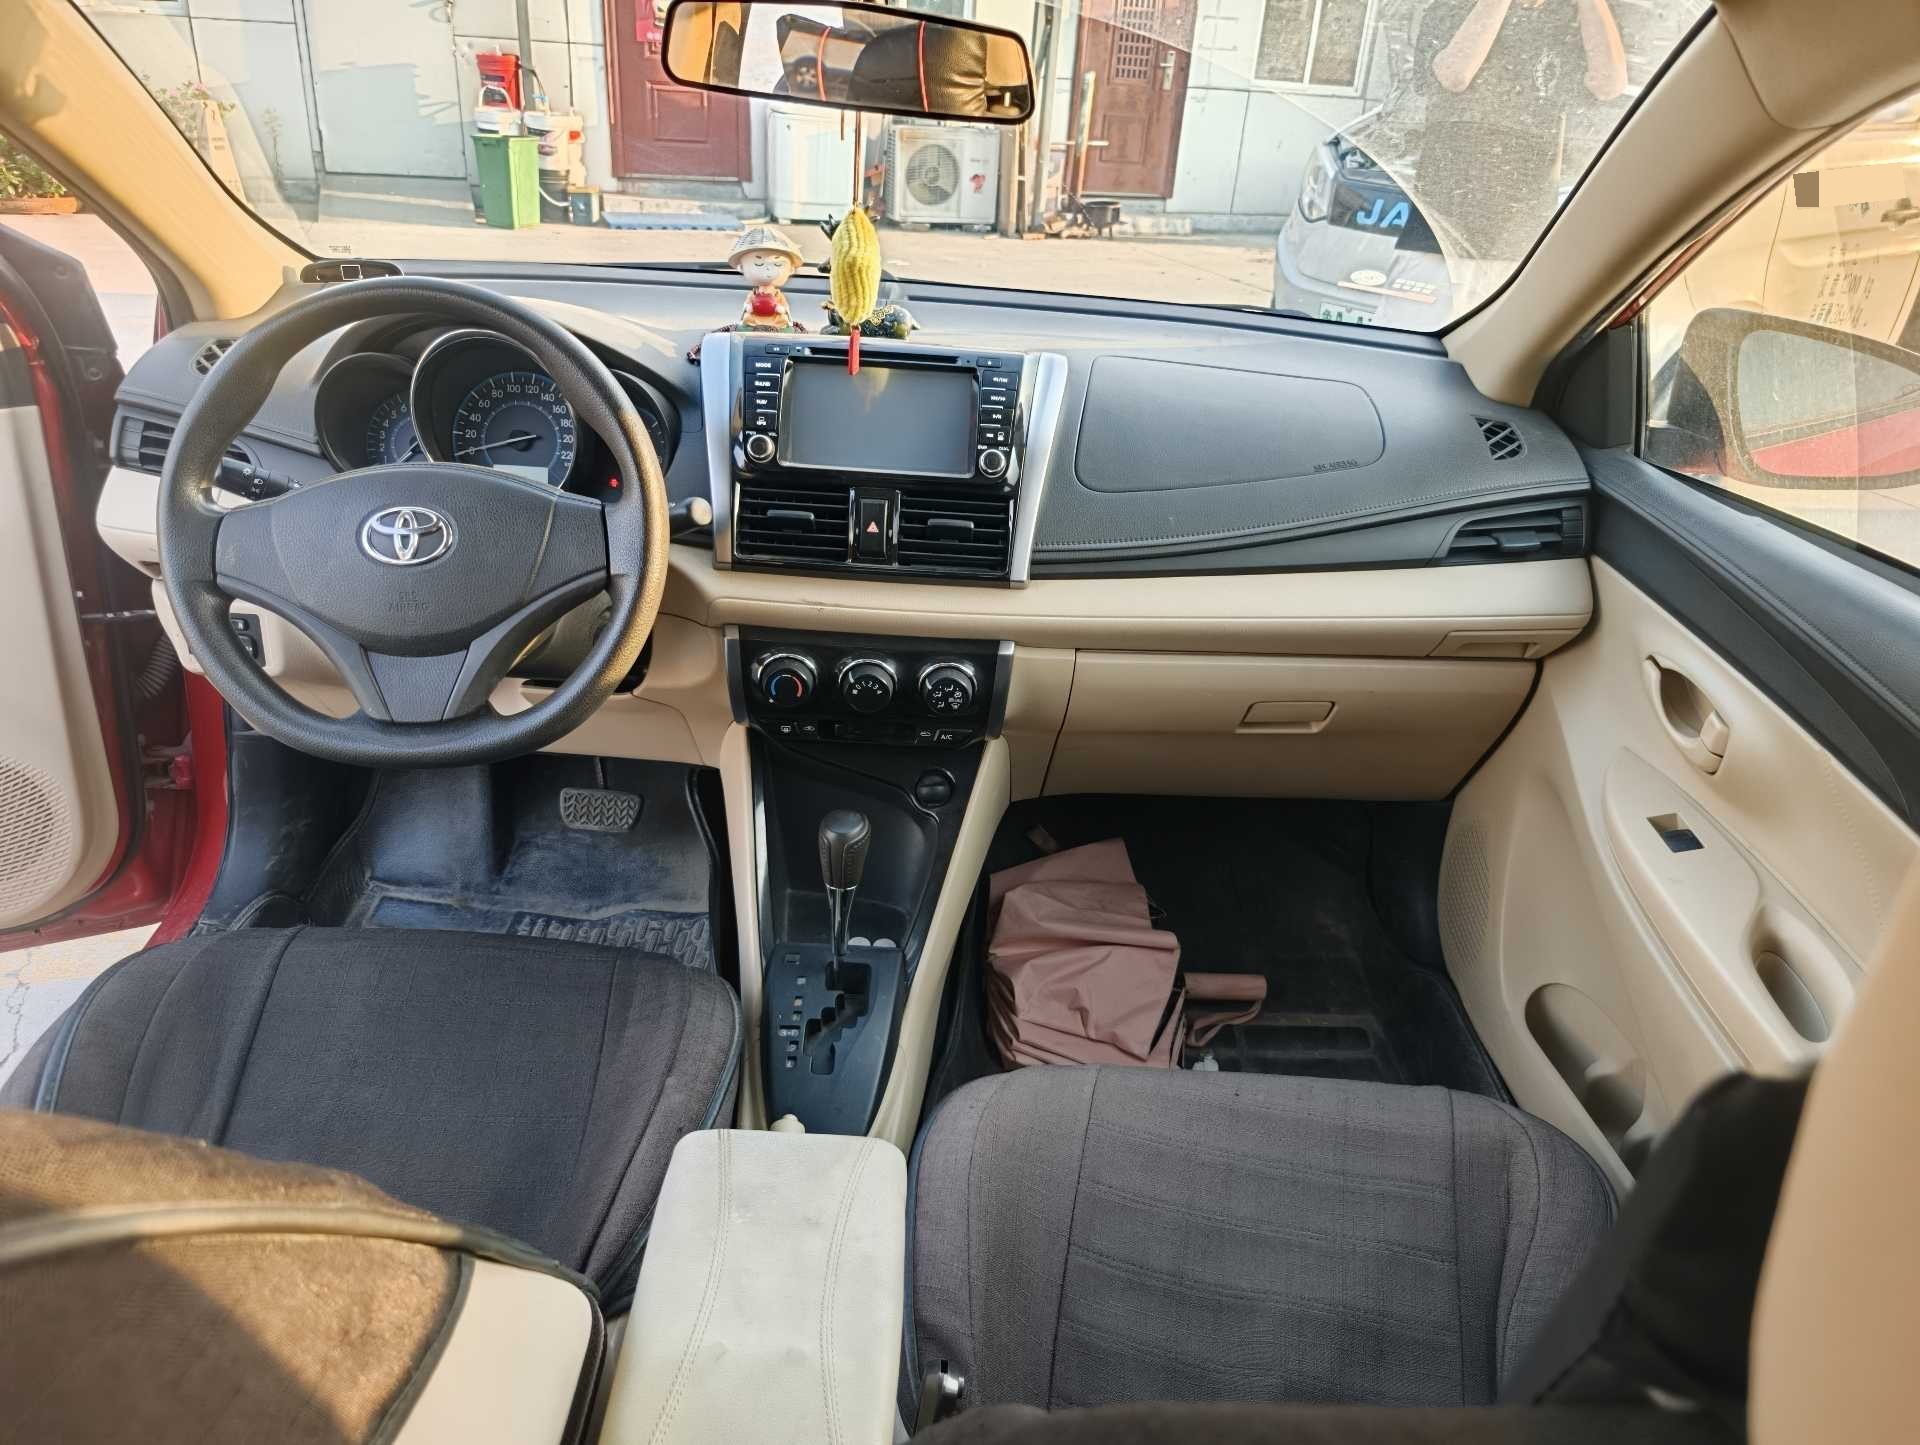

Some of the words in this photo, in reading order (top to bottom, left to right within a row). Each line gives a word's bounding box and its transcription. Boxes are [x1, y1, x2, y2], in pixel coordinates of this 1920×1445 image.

[1356, 199, 1410, 228] JA
[507, 385, 520, 393] 100
[525, 385, 539, 394] 120
[492, 390, 503, 398] 80
[541, 393, 555, 402] 140
[479, 400, 490, 408] 60
[553, 405, 566, 414] 160
[470, 414, 481, 422] 40
[465, 430, 477, 438] 20
